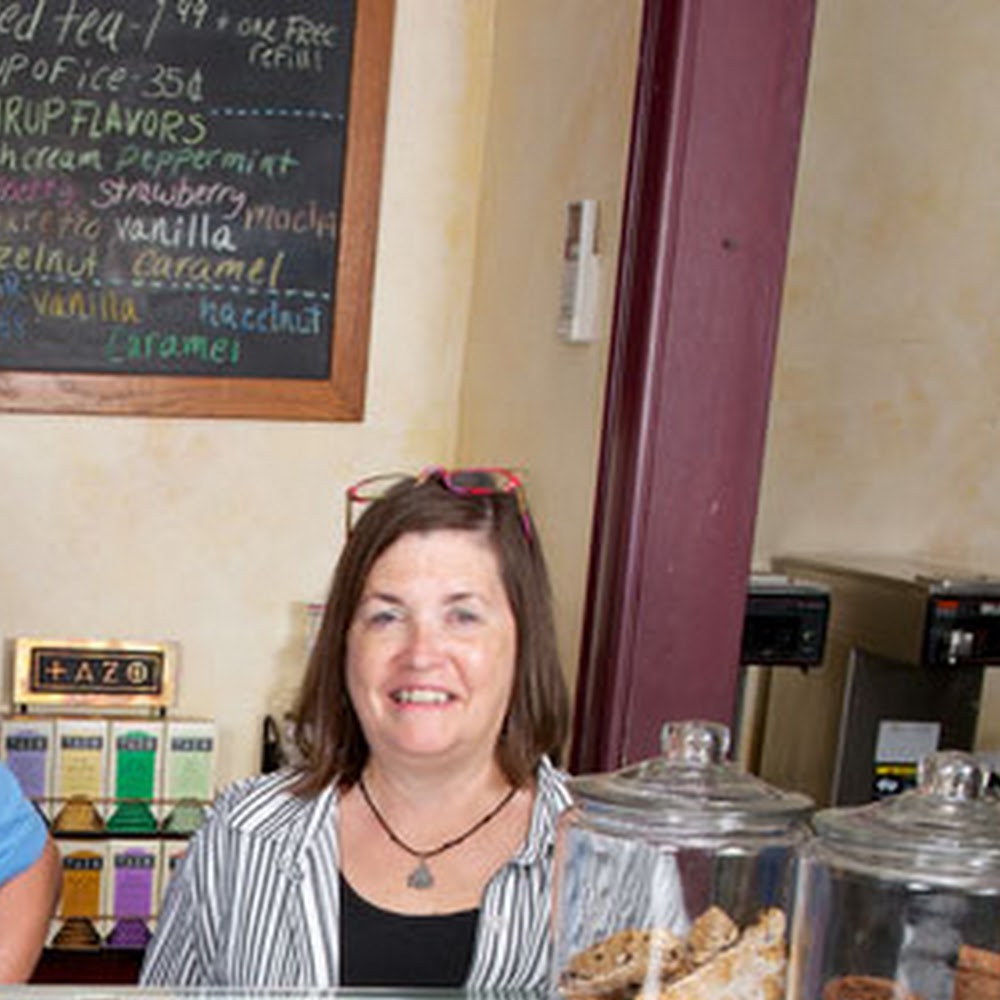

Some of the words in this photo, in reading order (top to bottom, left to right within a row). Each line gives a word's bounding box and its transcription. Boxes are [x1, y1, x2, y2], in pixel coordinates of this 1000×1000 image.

[70, 98, 208, 145] FLAVORS
[114, 212, 237, 253] vanilla
[31, 288, 141, 325] vanilla
